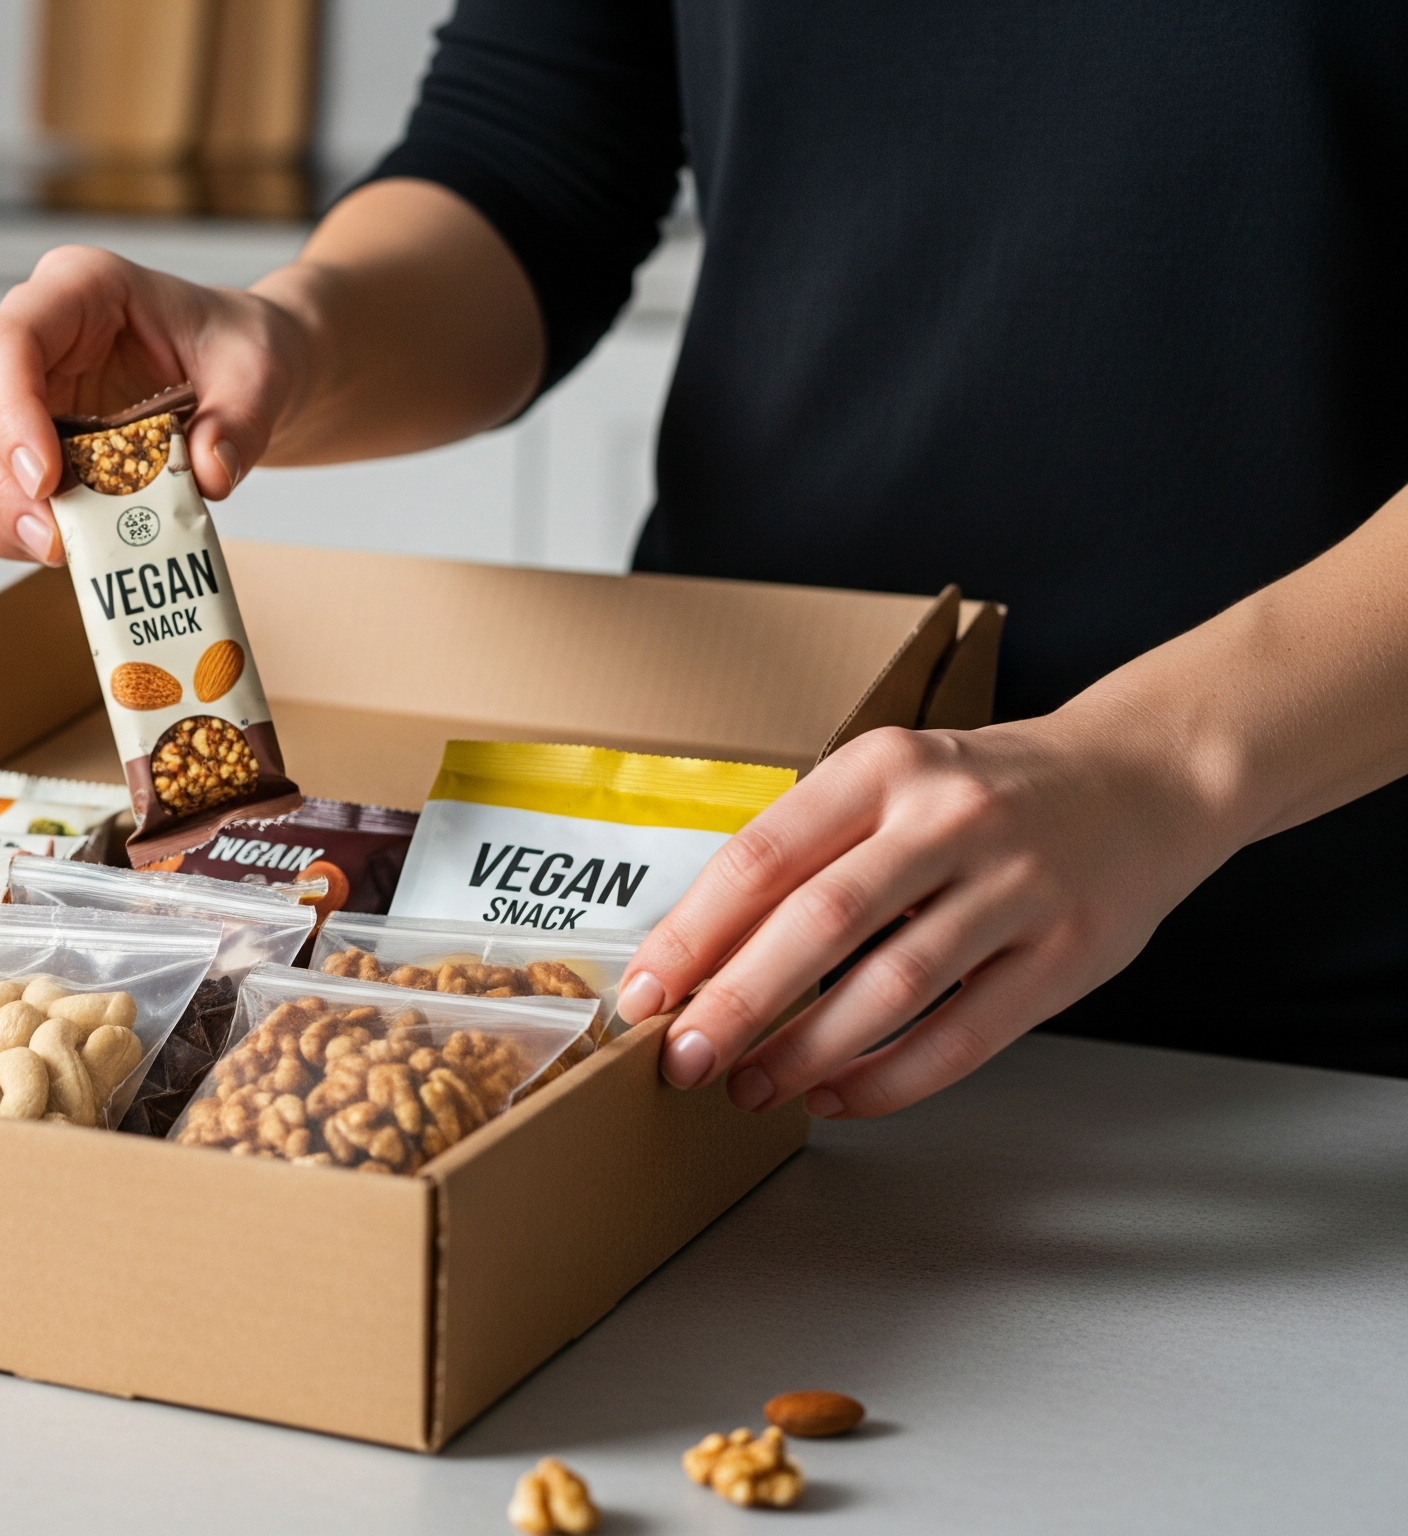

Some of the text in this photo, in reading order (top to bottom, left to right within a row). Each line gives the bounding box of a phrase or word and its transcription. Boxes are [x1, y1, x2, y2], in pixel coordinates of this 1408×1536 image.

[90, 549, 219, 620] VEGAN
[129, 606, 202, 646] SNACK
[468, 842, 650, 908] VEGAN
[482, 896, 587, 931] SNACK
